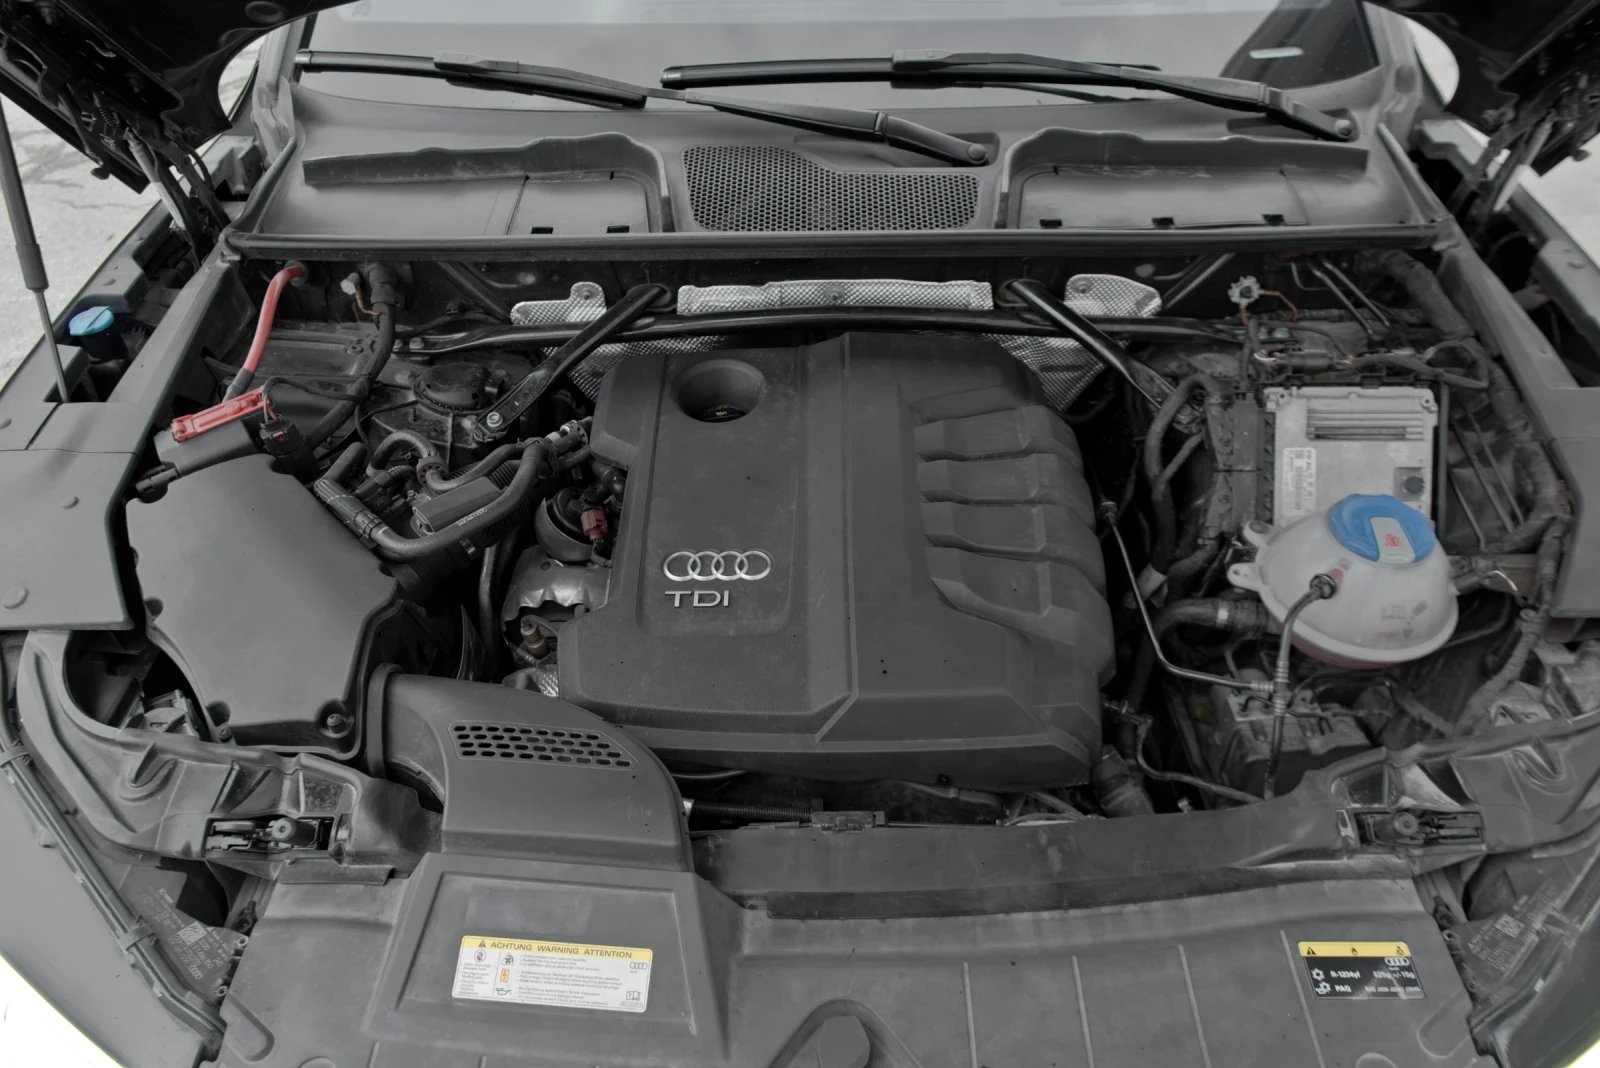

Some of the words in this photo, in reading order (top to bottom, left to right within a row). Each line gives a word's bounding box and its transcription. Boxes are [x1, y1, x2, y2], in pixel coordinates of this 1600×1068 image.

[665, 590, 730, 608] TDI
[490, 941, 533, 951] ACHTUNG
[537, 944, 579, 955] WARNING
[583, 948, 632, 959] ATTENTION
[1335, 985, 1352, 993] PAG
